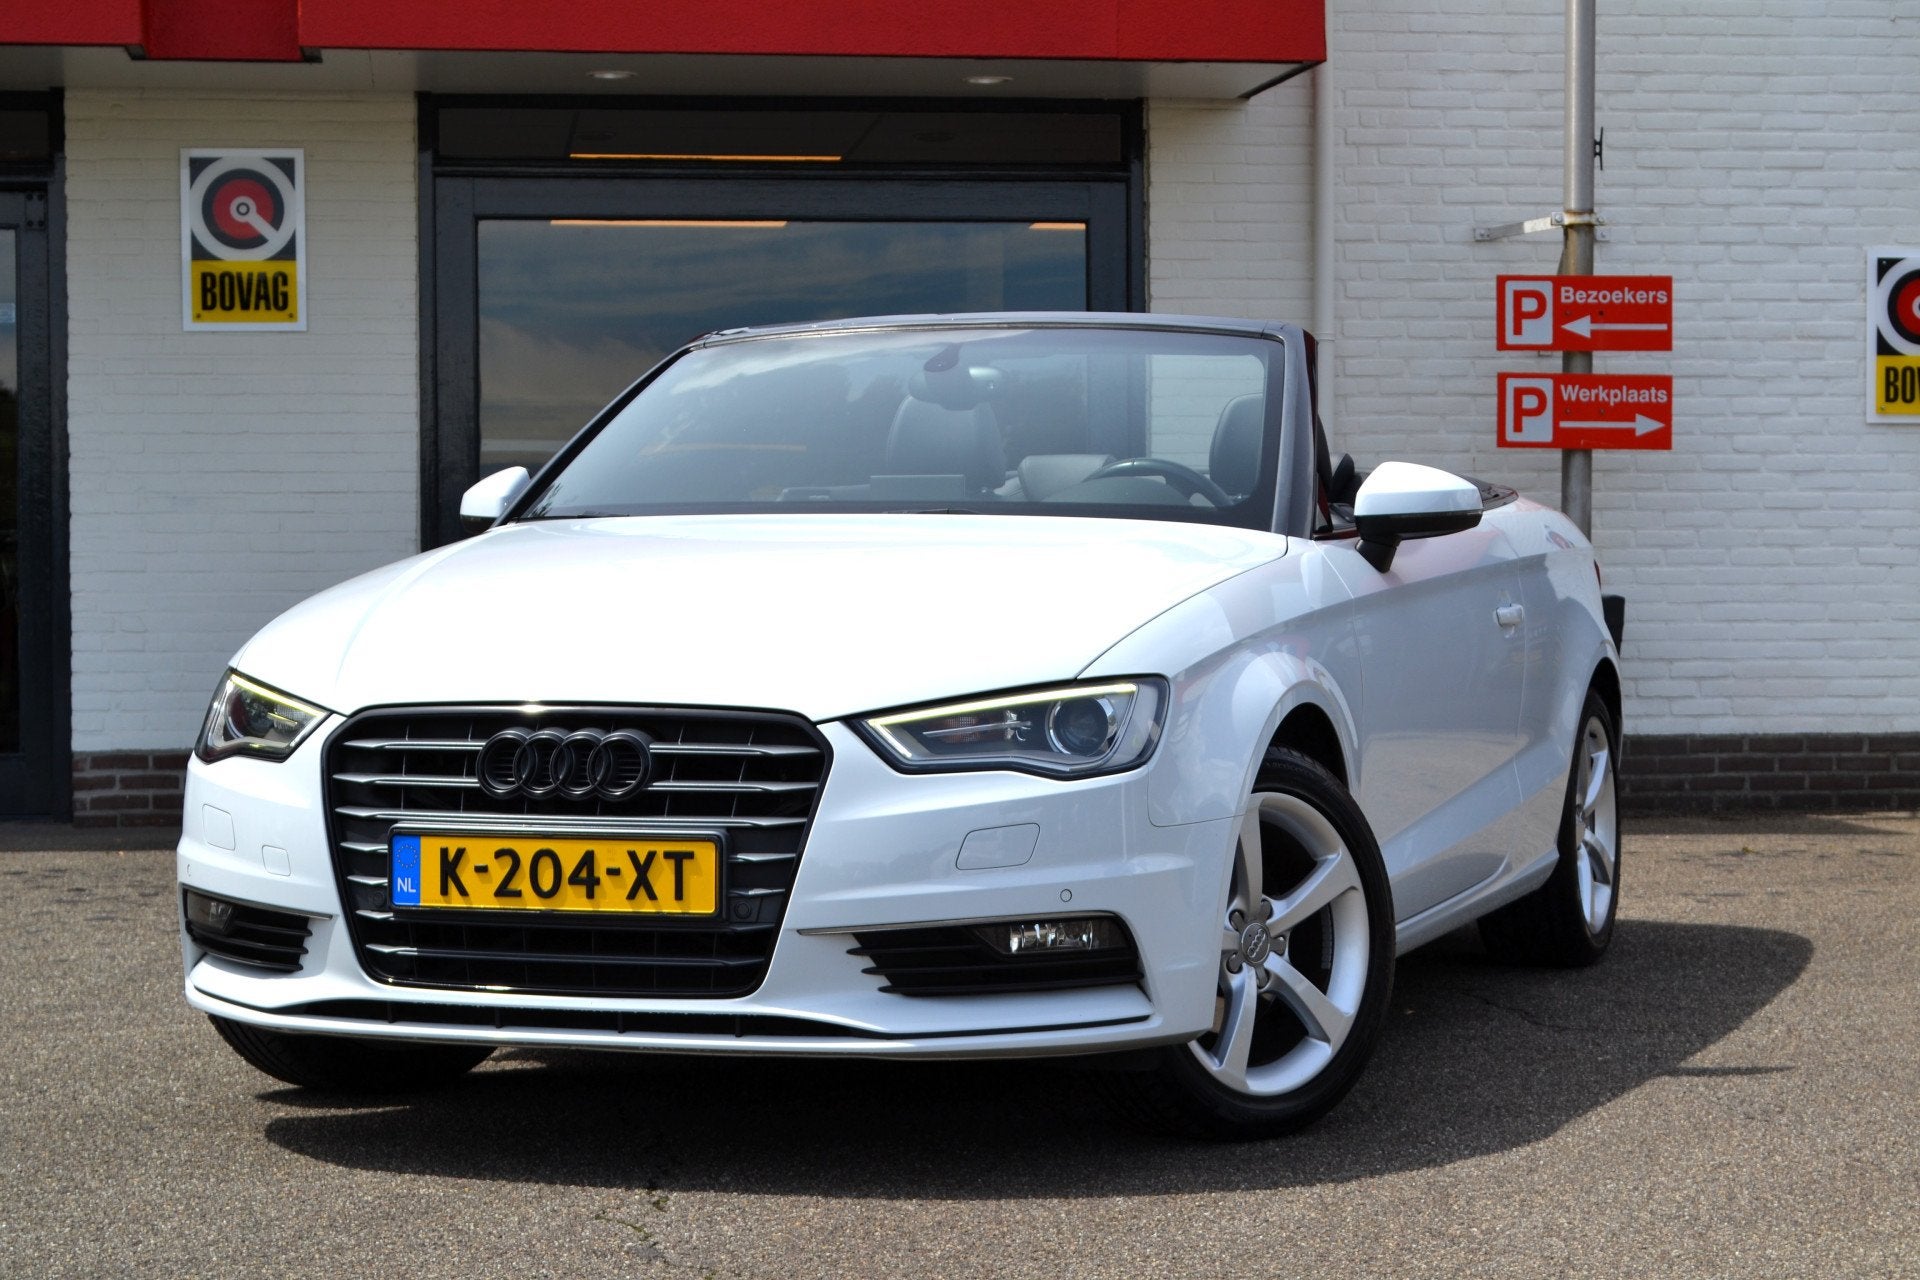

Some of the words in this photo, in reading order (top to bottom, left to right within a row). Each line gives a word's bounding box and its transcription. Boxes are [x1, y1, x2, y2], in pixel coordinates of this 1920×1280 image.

[201, 271, 289, 311] BOVAG
[1513, 289, 1547, 336] P
[1560, 286, 1668, 304] Bezoekers
[1513, 387, 1547, 433] P
[1560, 384, 1668, 406] Werkplaats
[1885, 366, 1920, 404] BO
[396, 876, 417, 894] NL
[439, 846, 695, 902] K-204-XT
